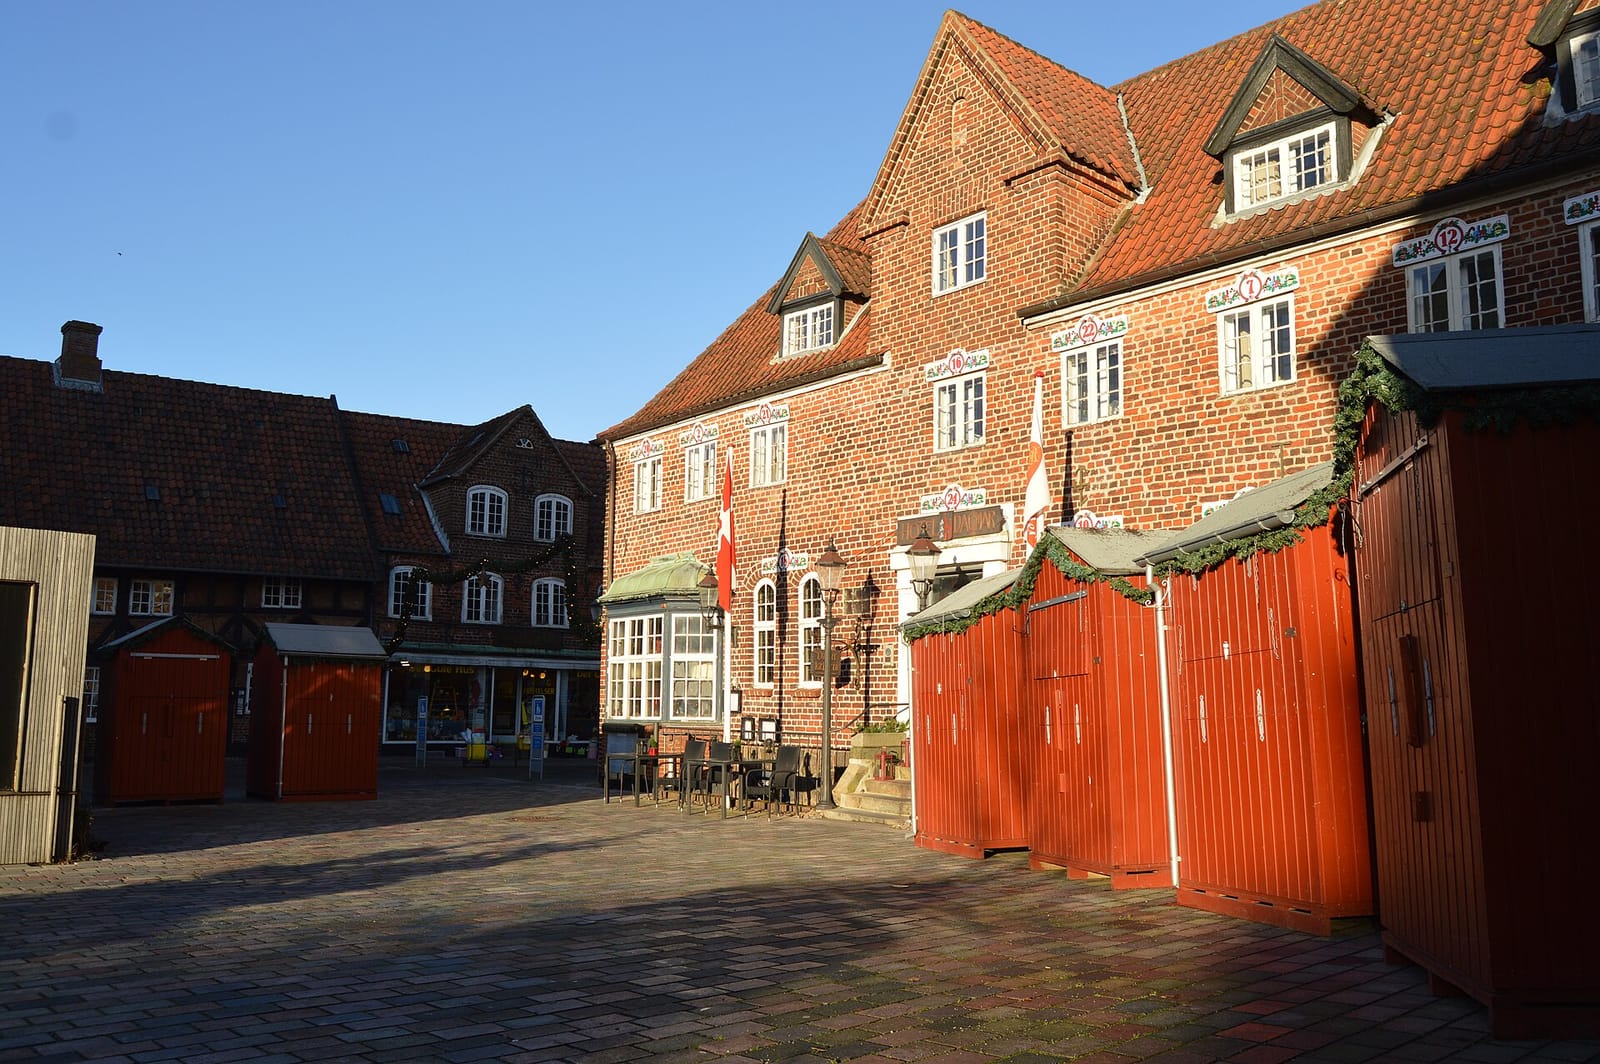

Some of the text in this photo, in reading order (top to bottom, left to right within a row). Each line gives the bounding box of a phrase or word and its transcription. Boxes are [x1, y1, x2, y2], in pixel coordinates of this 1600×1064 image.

[1439, 229, 1458, 247] 12
[1082, 323, 1095, 338] 22
[951, 356, 962, 370] 16
[761, 409, 770, 420] 21
[947, 493, 958, 505] 24
